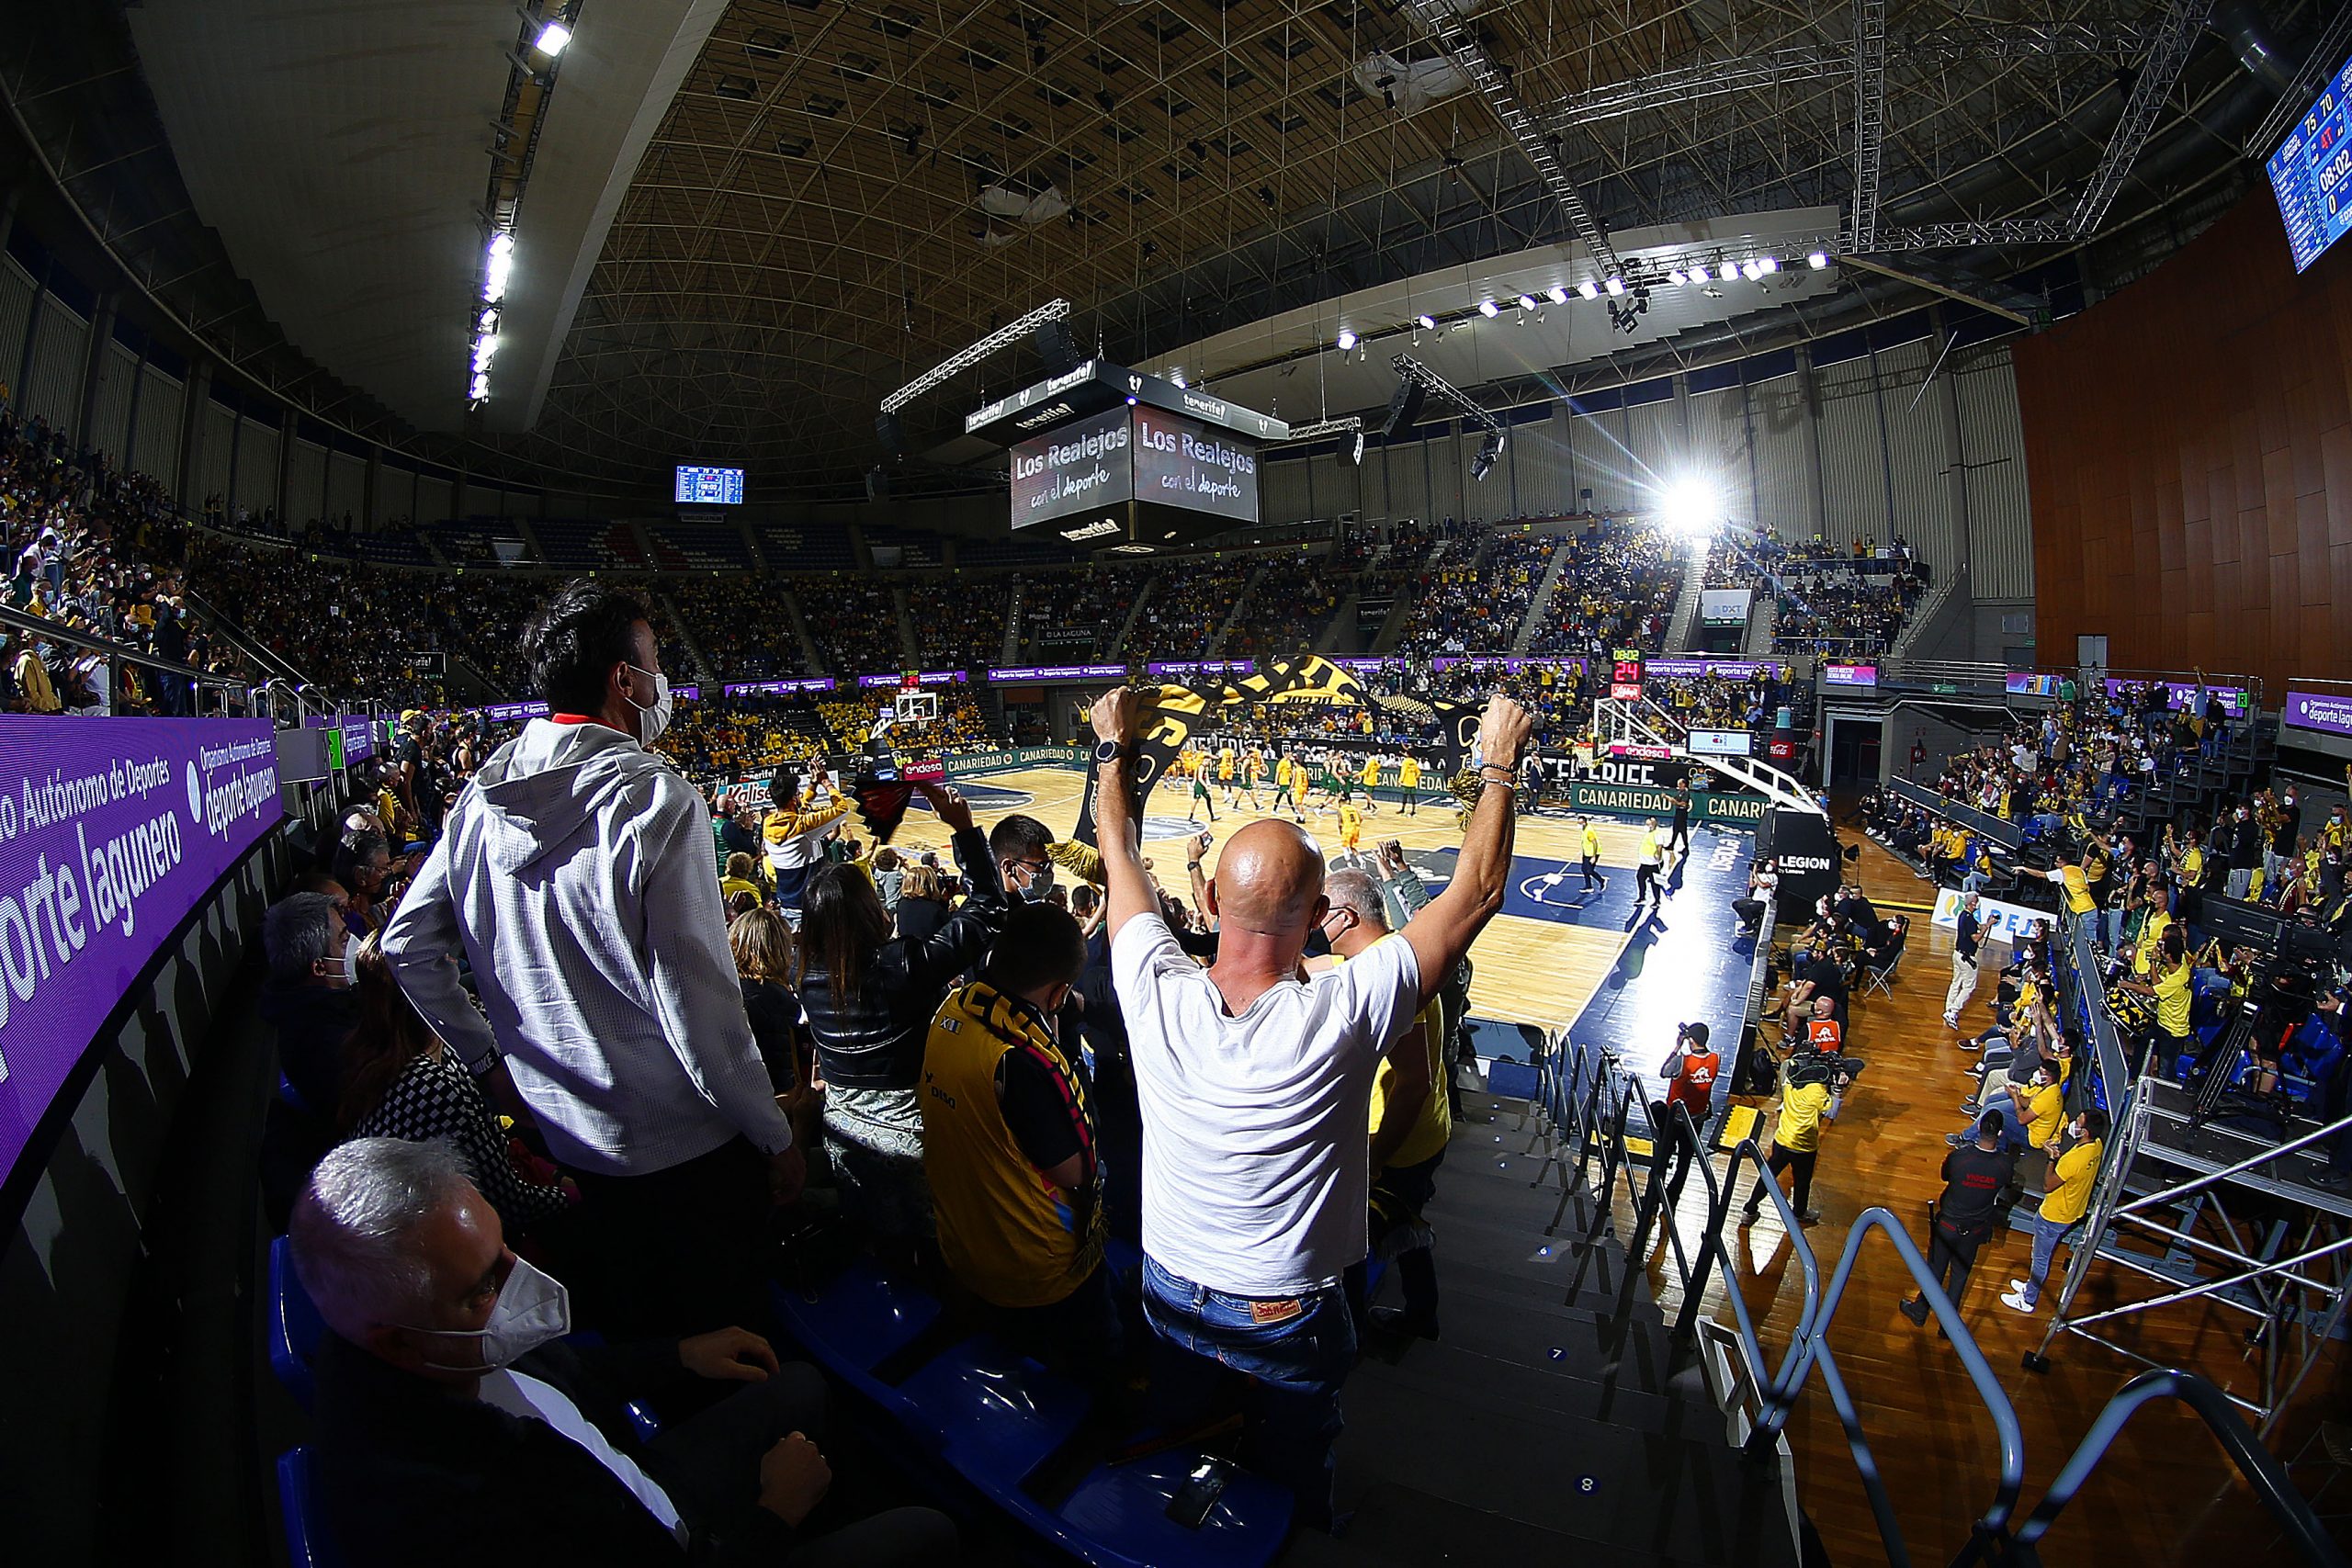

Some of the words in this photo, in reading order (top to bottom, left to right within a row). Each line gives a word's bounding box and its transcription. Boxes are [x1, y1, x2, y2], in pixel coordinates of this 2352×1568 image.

[2304, 113, 2317, 136] 75
[2320, 94, 2333, 117] 70
[2320, 149, 2351, 192] 08:02
[1183, 393, 1227, 421] tenerife!
[1016, 455, 1044, 480] Los
[1048, 426, 1128, 469] Realejos
[1143, 422, 1177, 452] Los
[1182, 432, 1255, 475] Realejos
[1031, 490, 1049, 509] con
[1051, 473, 1060, 500] el
[1063, 462, 1111, 500] deporte
[1161, 474, 1182, 491] con
[1185, 466, 1195, 492] el
[1198, 472, 1240, 503] deporte
[1722, 605, 1742, 614] DXT
[1063, 629, 1091, 637] LAGUNA
[1612, 650, 1639, 660] 08:02
[1614, 661, 1638, 682] 24
[1645, 665, 1670, 674] deporte
[1671, 665, 1701, 675] lagunero
[2239, 694, 2246, 705] R
[2309, 706, 2338, 724] deporte
[1020, 748, 1066, 762] CANARIEDAD
[1625, 746, 1665, 759] endesa
[906, 762, 944, 775] endesa
[948, 755, 1002, 773] CANARIEDAD
[23, 768, 109, 833] Autónomo
[109, 758, 125, 802] de
[125, 754, 171, 802] Deportes
[205, 772, 245, 842] deporte
[241, 761, 276, 819] lagunero
[1578, 787, 1672, 812] CANARIEDAD
[1779, 855, 1830, 871] LEGION
[76, 809, 183, 939] lagunero
[1540, 1247, 1548, 1256] 6
[1553, 1348, 1562, 1359] 7
[1581, 1478, 1593, 1492] 8
